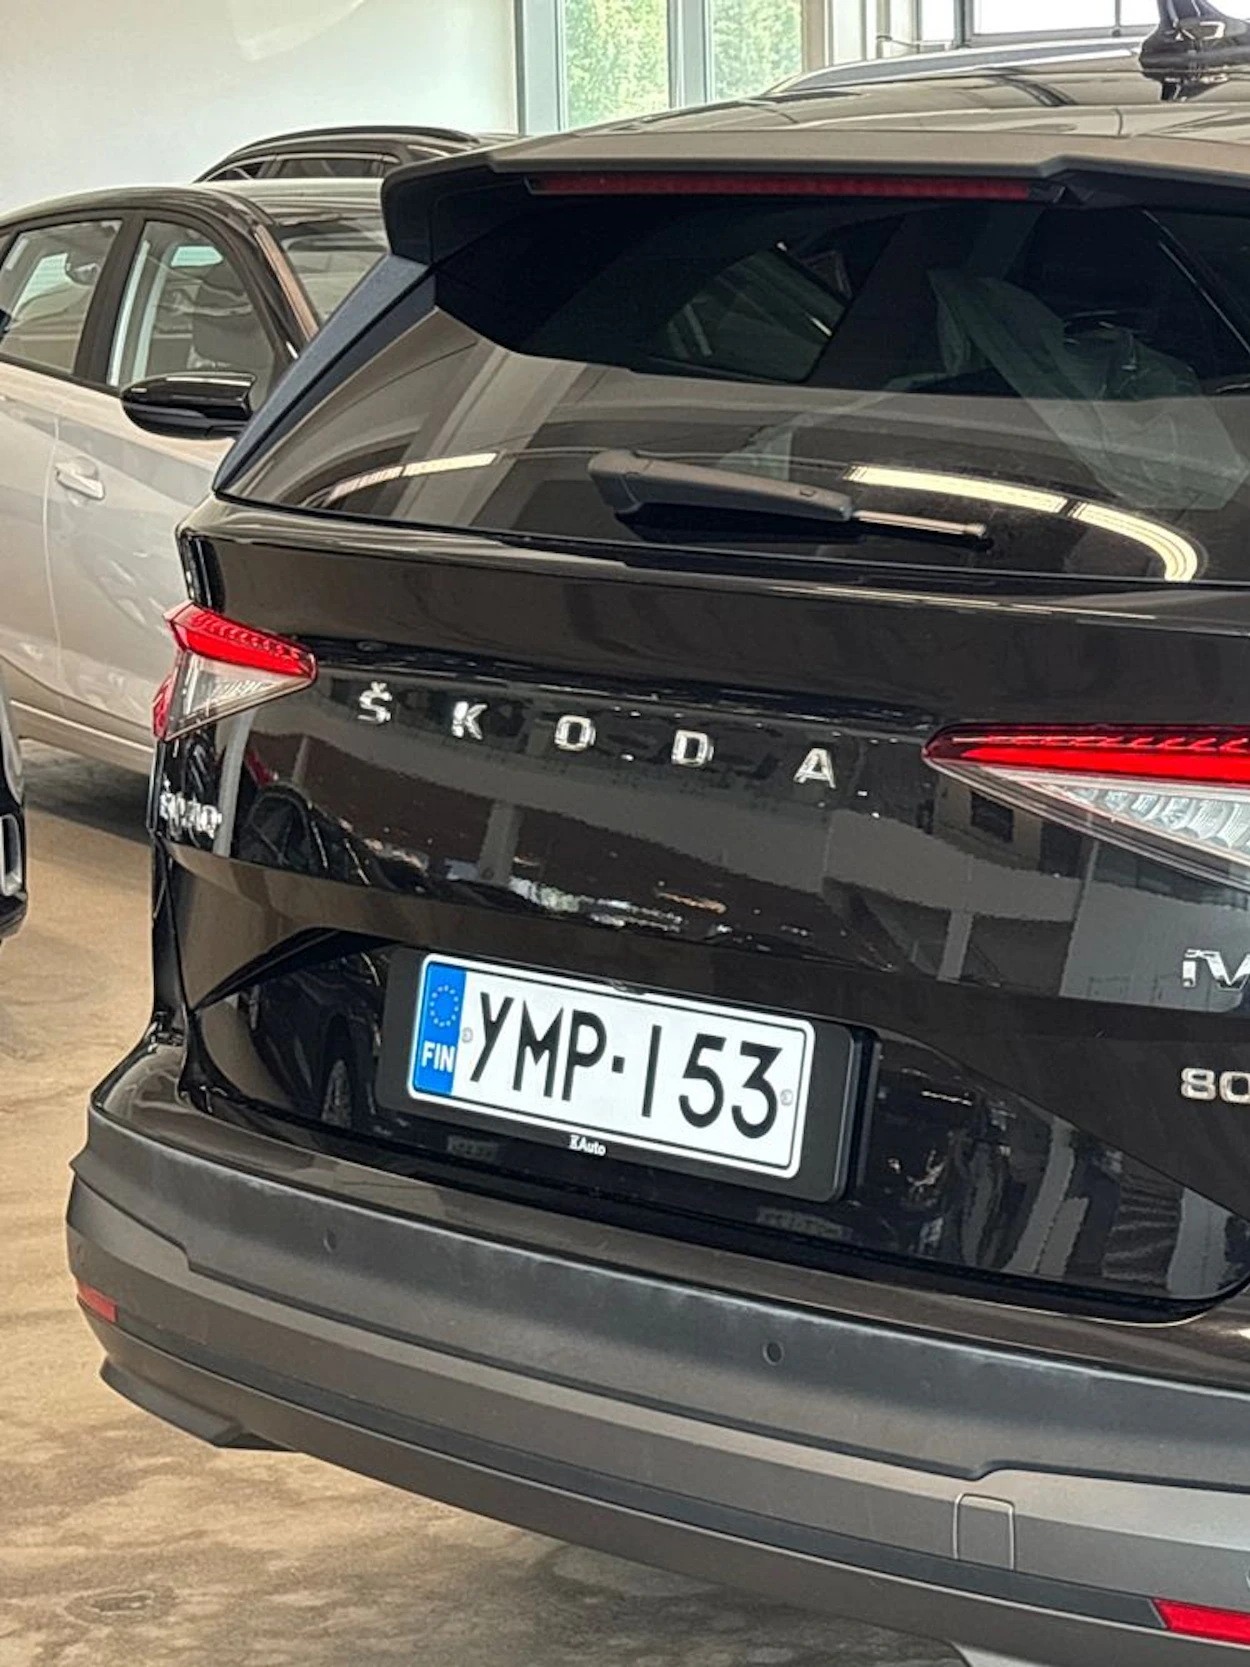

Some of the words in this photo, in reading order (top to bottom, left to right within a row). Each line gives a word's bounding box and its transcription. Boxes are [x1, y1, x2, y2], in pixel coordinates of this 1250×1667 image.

[358, 680, 837, 790] ŠKODA
[420, 1040, 455, 1074] FIN
[469, 991, 784, 1140] YMP-153
